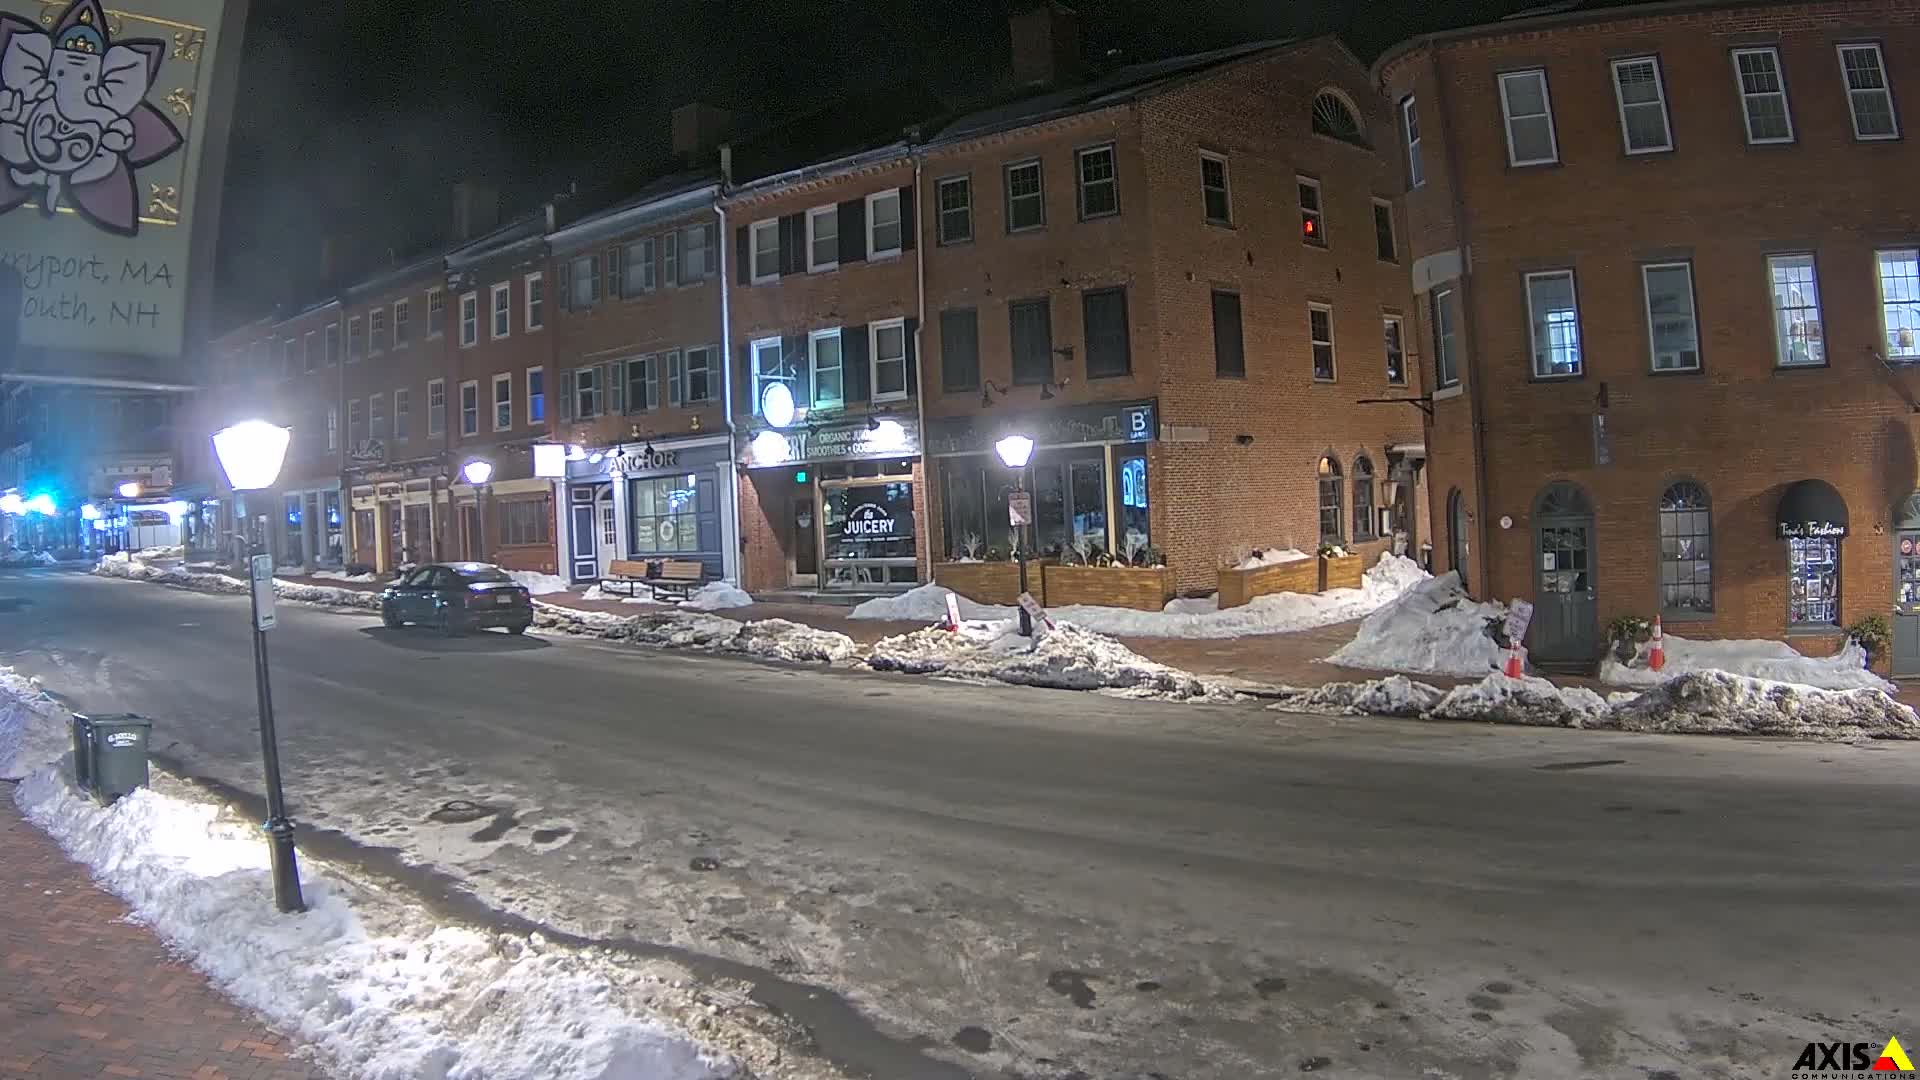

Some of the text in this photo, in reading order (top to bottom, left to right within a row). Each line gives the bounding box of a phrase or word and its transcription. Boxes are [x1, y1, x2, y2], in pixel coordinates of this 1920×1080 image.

[119, 258, 174, 288] MA
[109, 300, 160, 329] NH
[819, 432, 851, 444] ORGANIC
[806, 445, 847, 457] SMOOTHIES
[609, 451, 681, 472] ANCHOR
[843, 518, 895, 534] JUICERY
